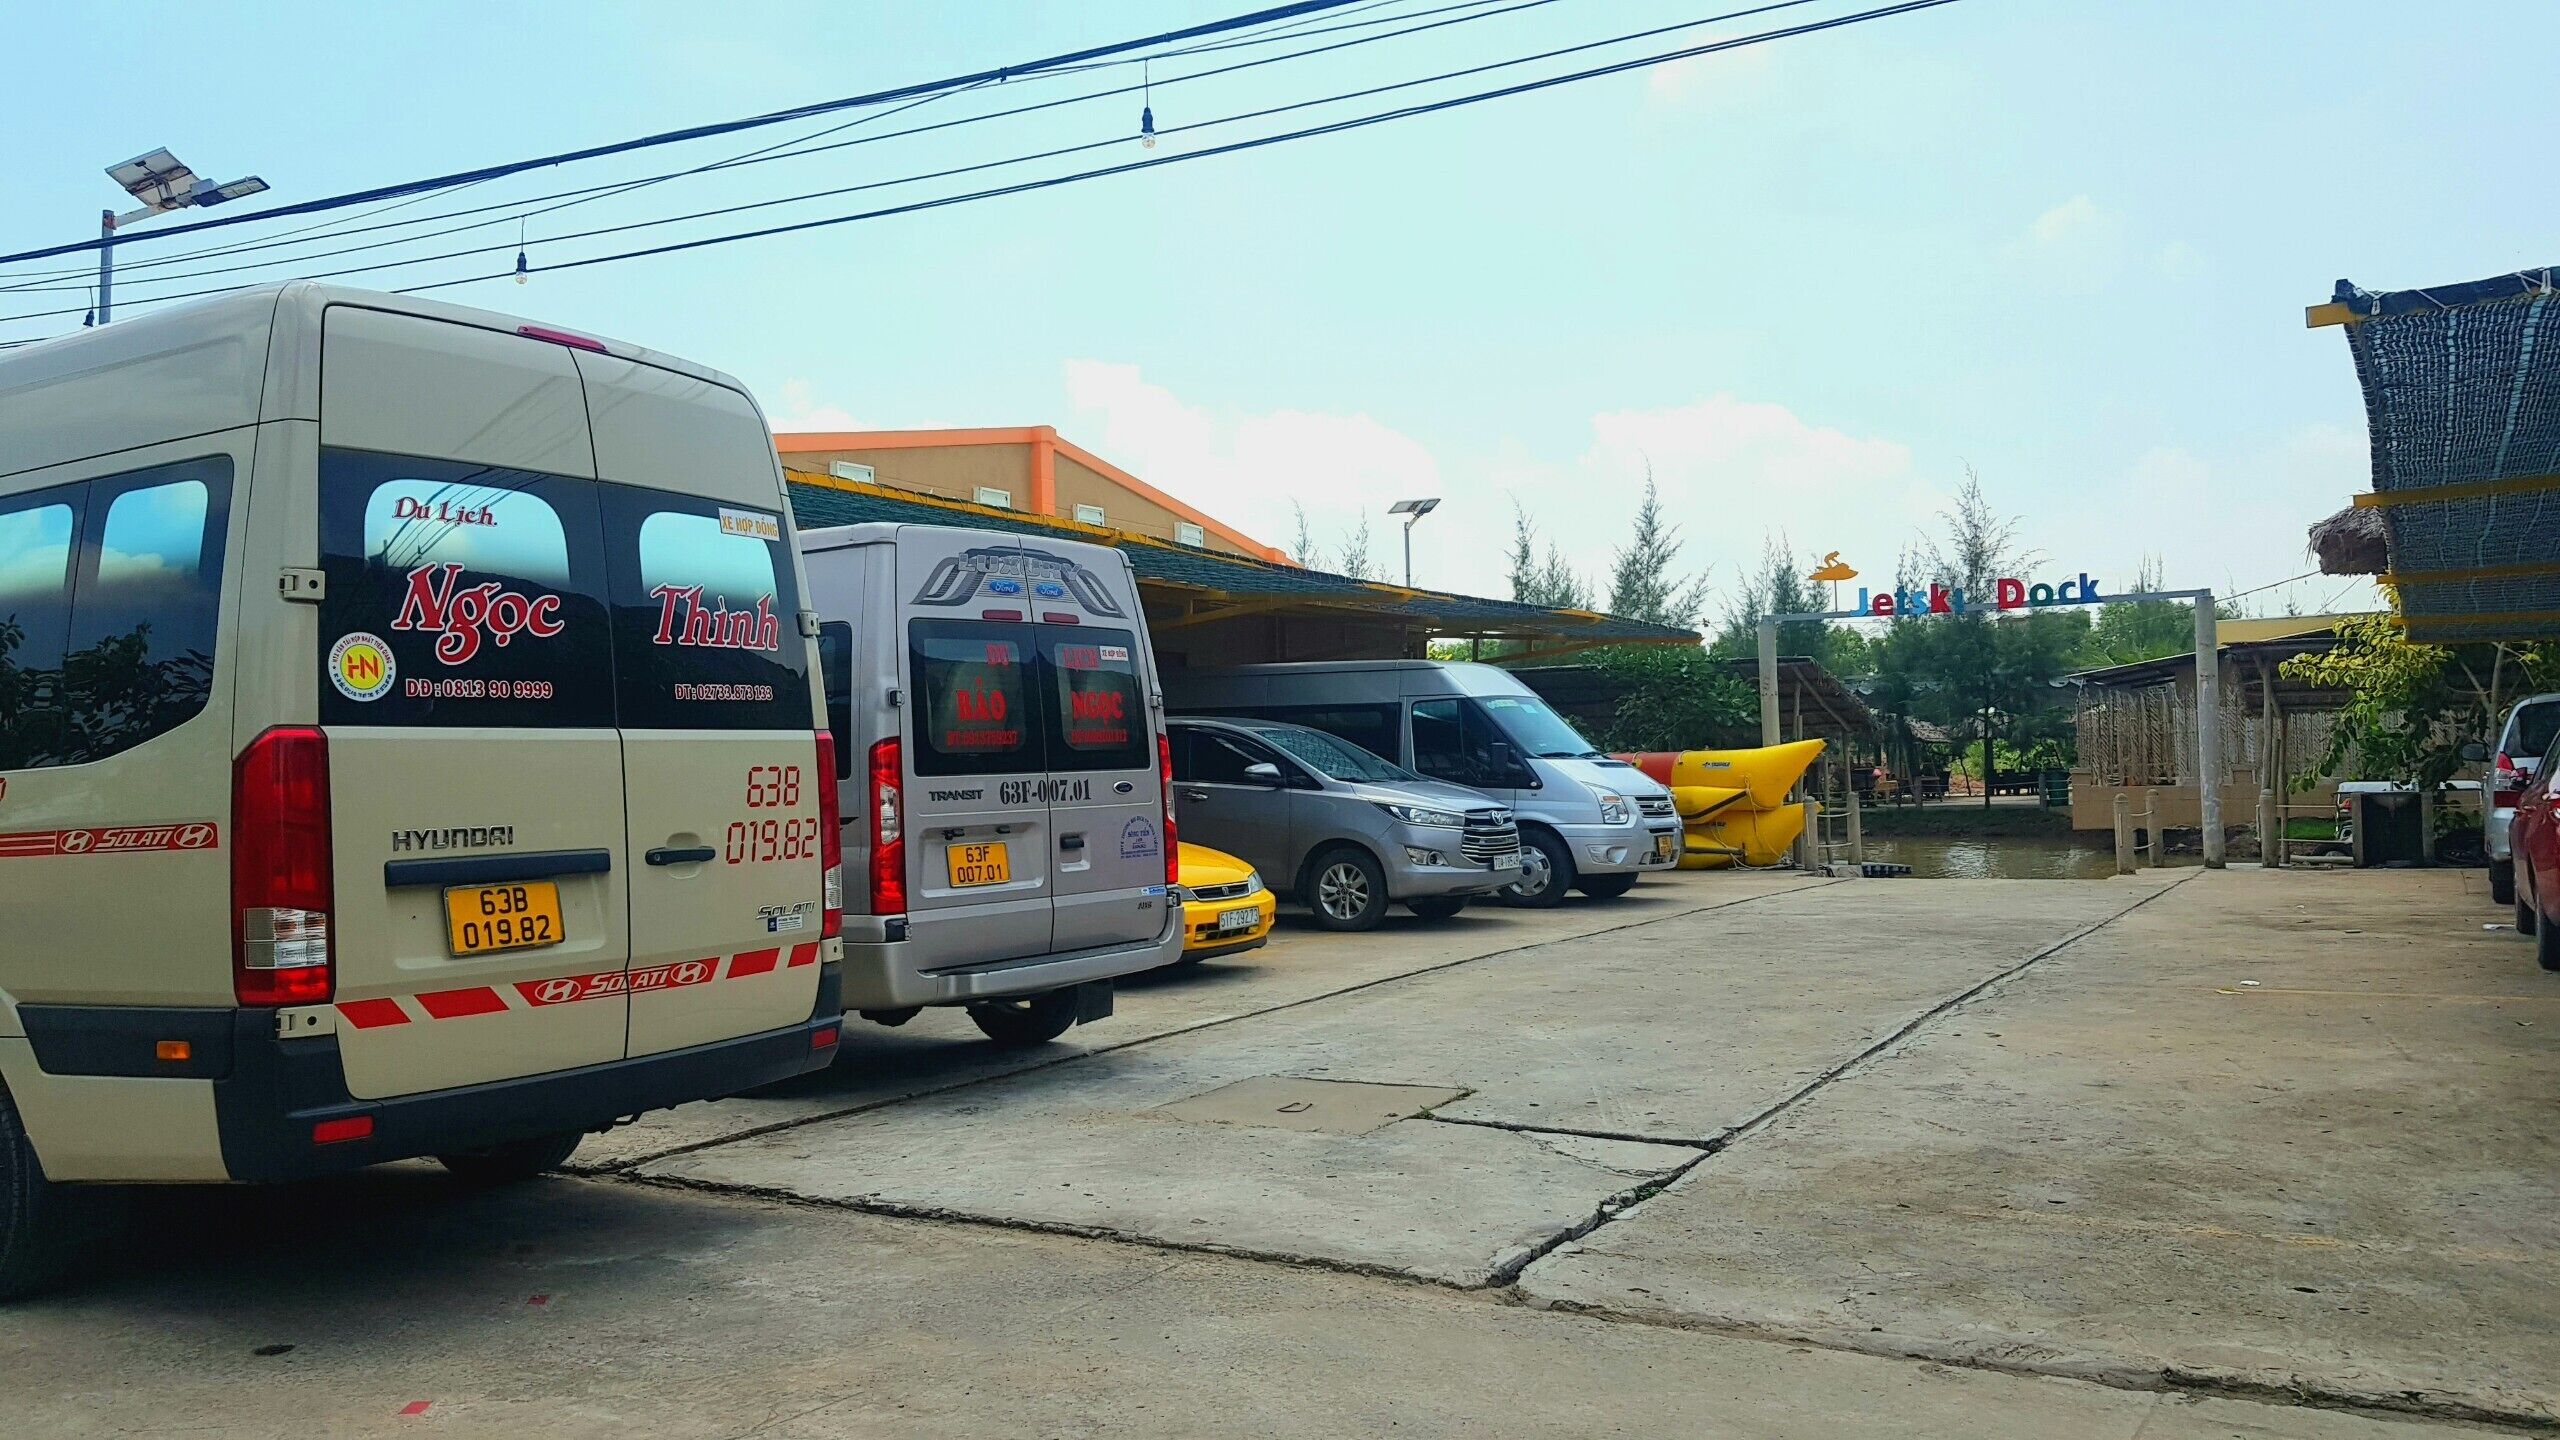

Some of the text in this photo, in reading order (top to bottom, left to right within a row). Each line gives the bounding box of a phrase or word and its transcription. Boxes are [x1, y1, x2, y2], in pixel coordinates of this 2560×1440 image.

[393, 496, 430, 519] Du
[722, 515, 734, 531] XE
[958, 552, 1082, 581] LUXURY
[1850, 573, 2099, 617] Jetski Dock
[391, 561, 565, 665] Ngọc
[488, 680, 510, 698] 90
[513, 681, 553, 698] 9999
[747, 766, 800, 807] 63B
[928, 789, 984, 801] TRANSIT
[1000, 779, 1091, 804] 63F-007.01
[95, 830, 174, 848] SOLATI
[392, 825, 513, 851] HYUNDAI
[726, 818, 817, 864] 019.82
[966, 846, 990, 863] 63F
[957, 864, 1002, 883] 007.01
[479, 887, 528, 916] 63B
[756, 901, 815, 920] SOLATI
[463, 915, 551, 949] 019.82
[583, 970, 670, 996] SOLATI
